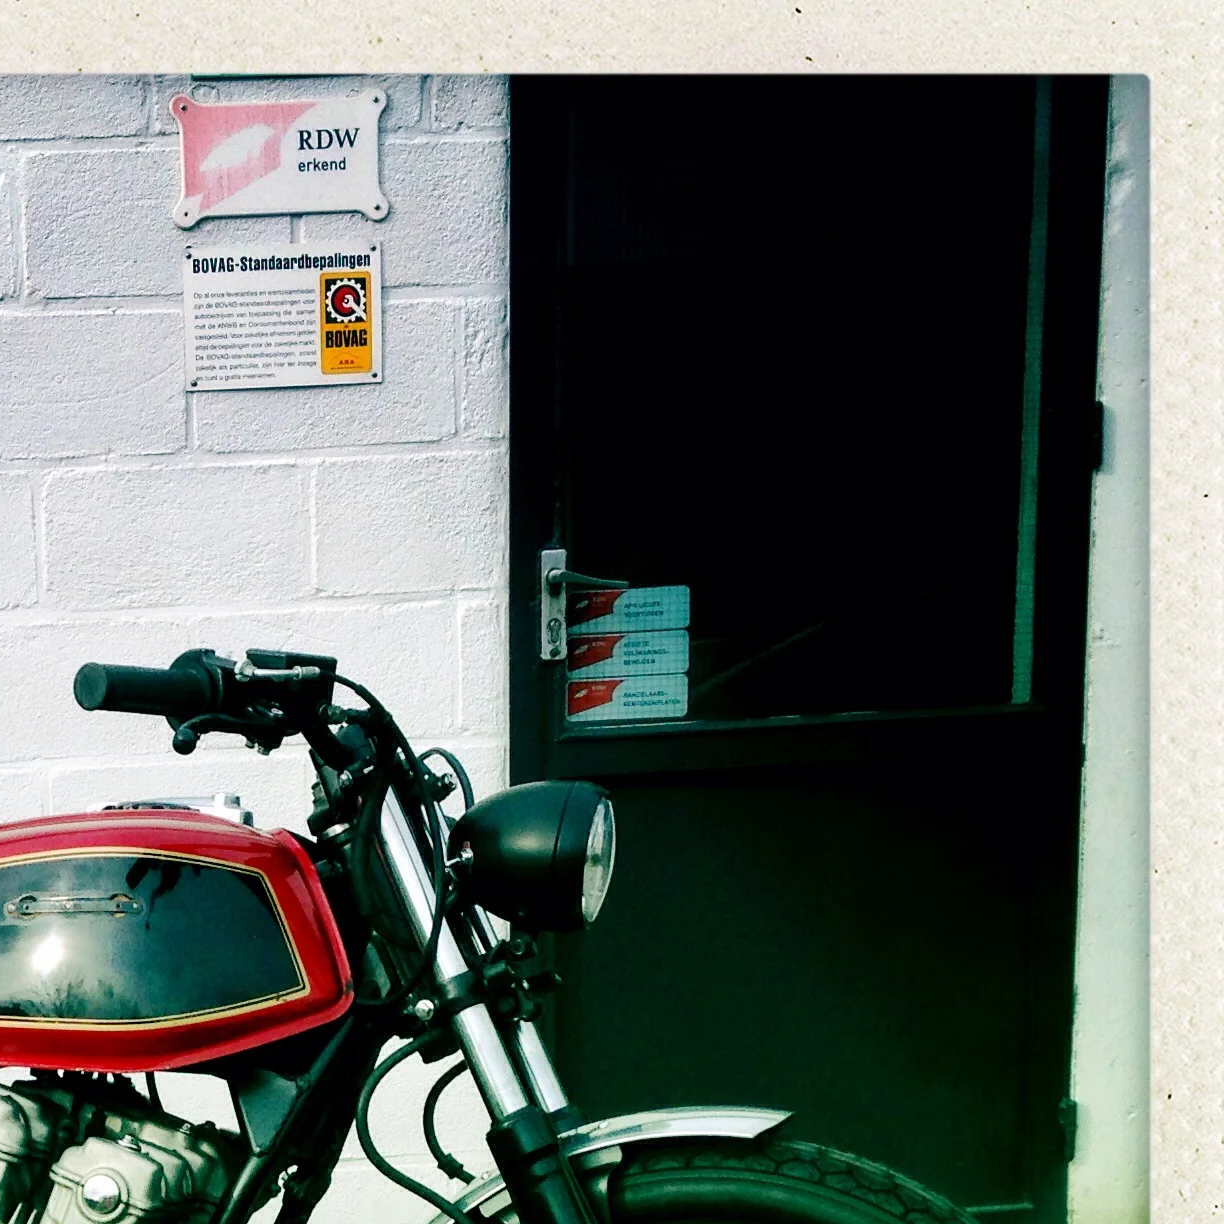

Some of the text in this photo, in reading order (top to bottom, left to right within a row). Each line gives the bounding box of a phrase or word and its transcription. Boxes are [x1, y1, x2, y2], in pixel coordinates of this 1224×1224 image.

[297, 127, 360, 151] RDW
[297, 156, 347, 172] erkend
[192, 252, 371, 274] BOVAG-Standaardbepalingen
[325, 329, 368, 348] BOVAG
